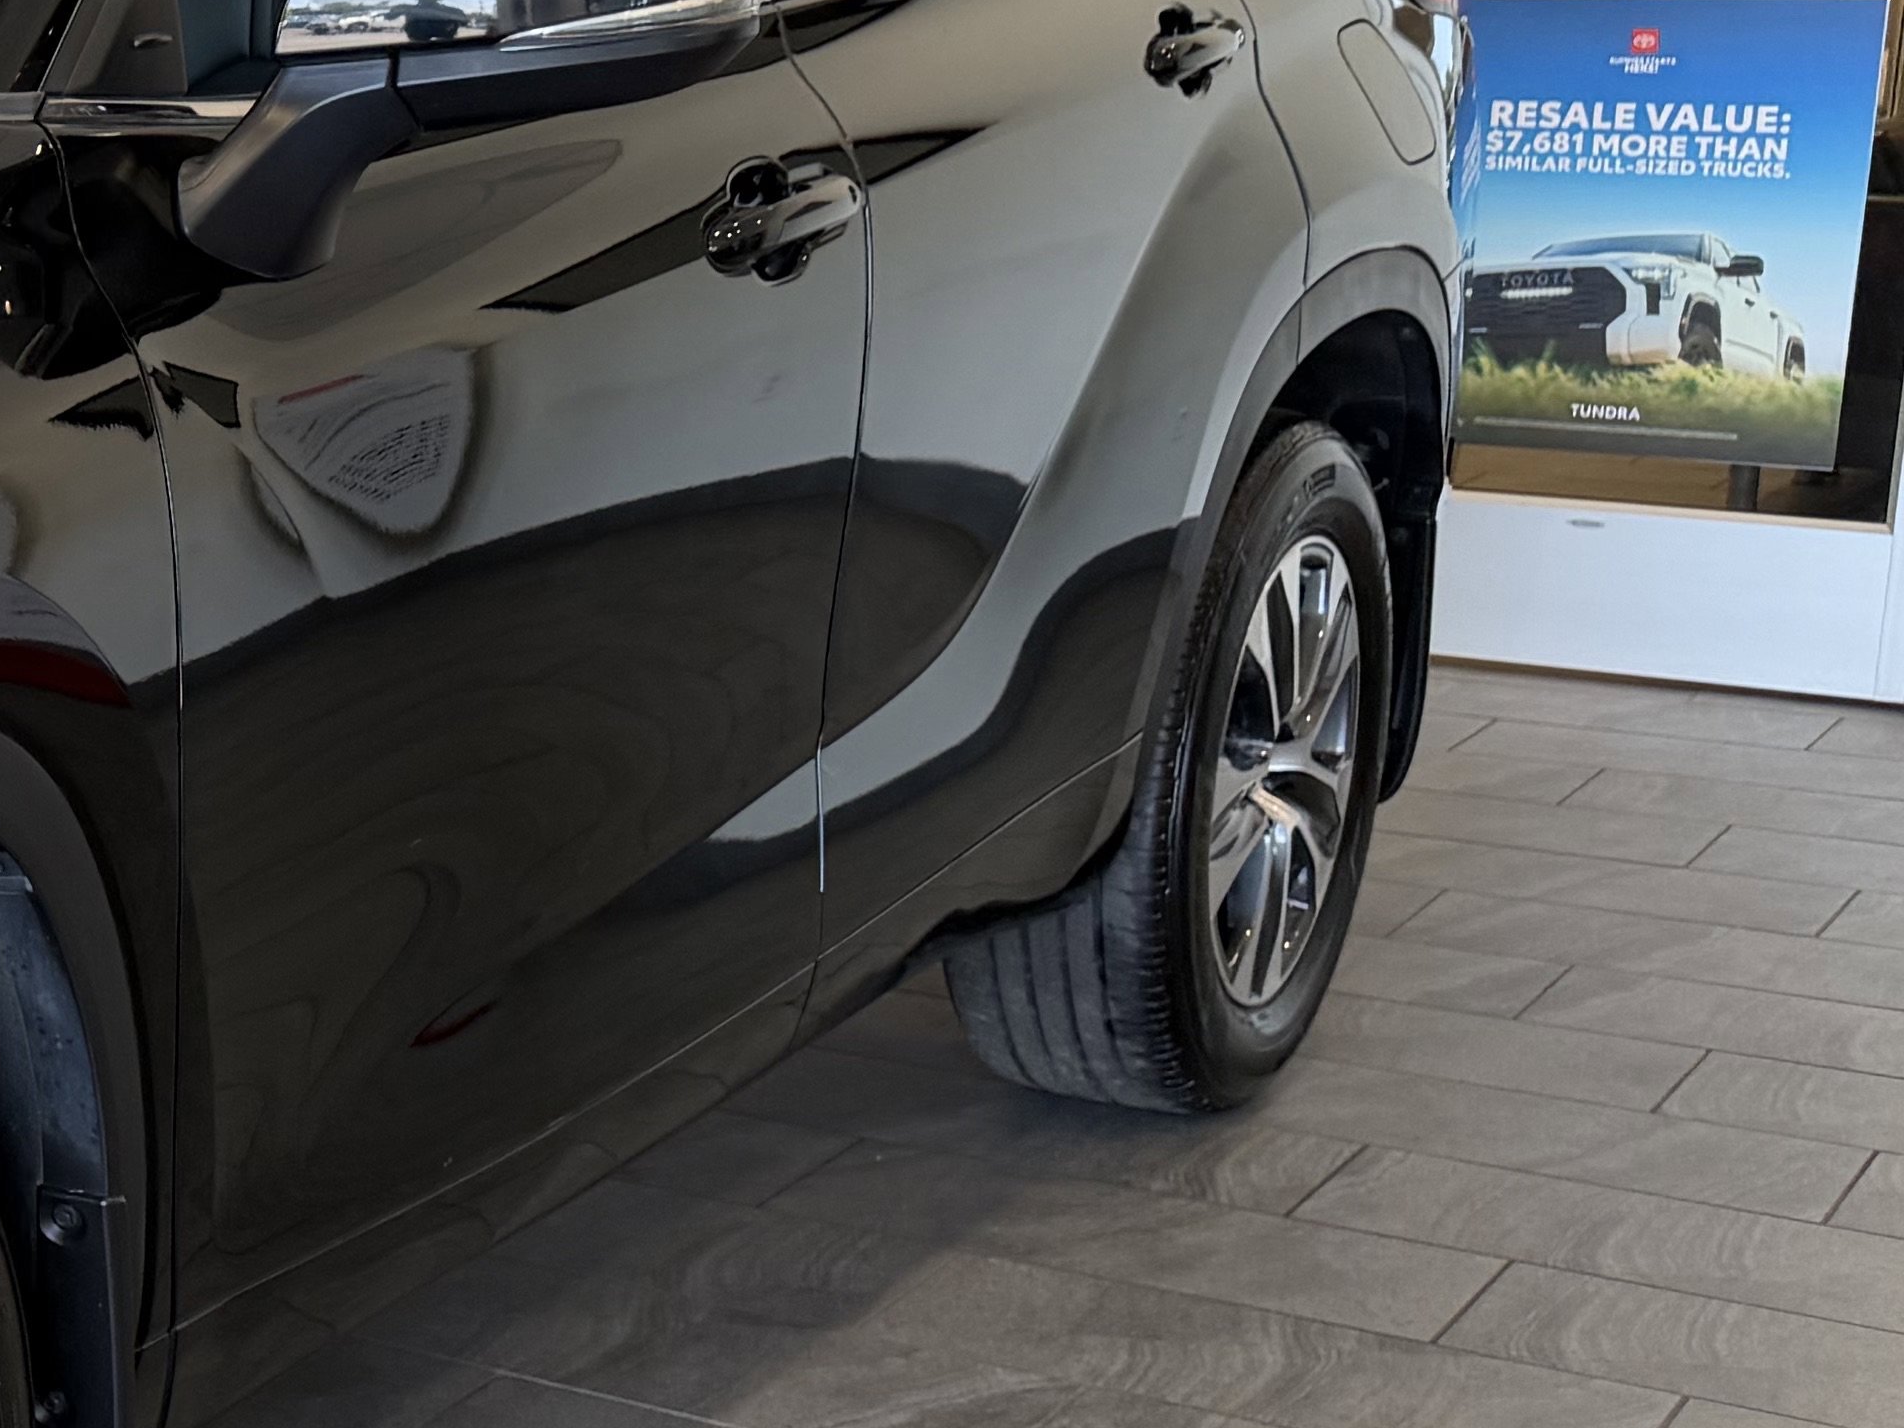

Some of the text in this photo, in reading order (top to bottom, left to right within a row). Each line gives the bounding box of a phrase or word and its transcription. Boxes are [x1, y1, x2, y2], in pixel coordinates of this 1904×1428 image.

[1489, 99, 1792, 135] RESALE VALUE:
[1484, 128, 1790, 161] $7,681 MORE THAN
[1484, 154, 1791, 180] SIMILAR FULL-SIZED TRUCKS.
[1499, 269, 1574, 288] TOYOTA
[1571, 402, 1641, 422] TUNDRA
